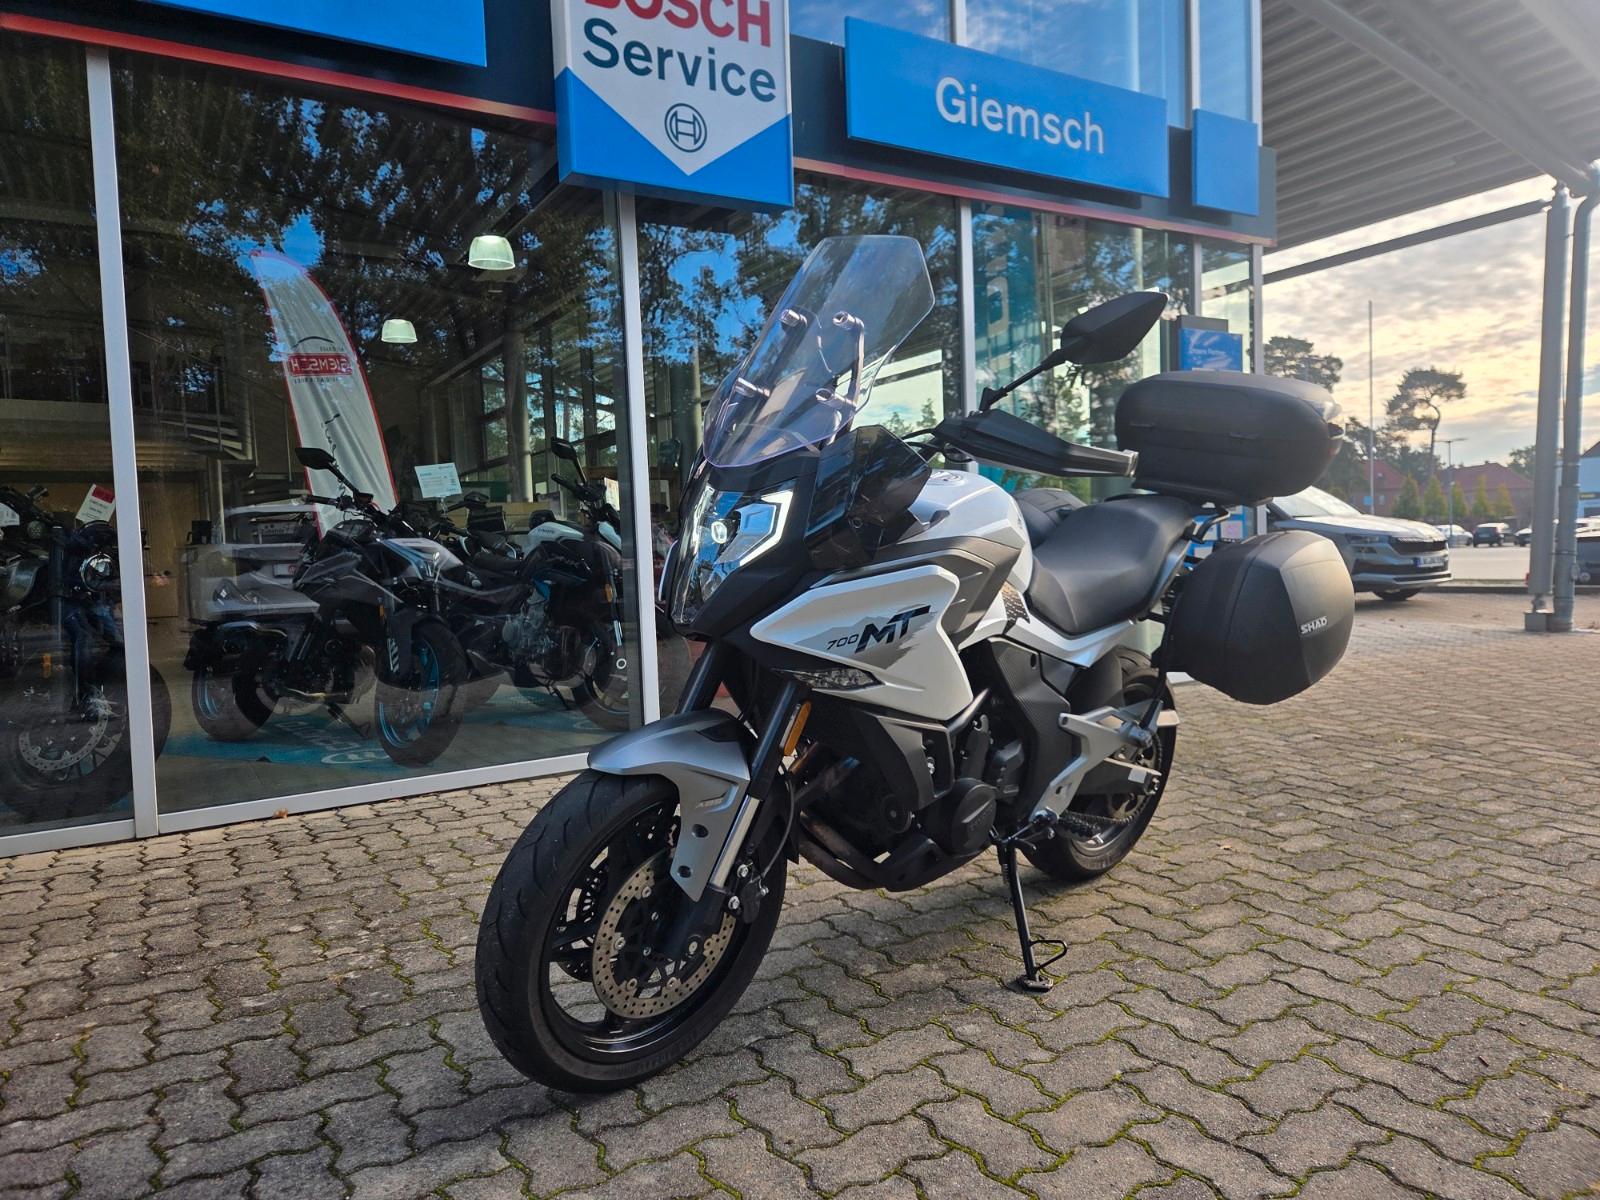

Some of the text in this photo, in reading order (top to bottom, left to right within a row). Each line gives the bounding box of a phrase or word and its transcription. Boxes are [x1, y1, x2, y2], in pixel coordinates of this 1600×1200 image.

[585, 0, 771, 47] SCH
[583, 18, 776, 102] Service
[935, 76, 1104, 154] Giemsch
[826, 605, 931, 654] 700 MT
[1300, 616, 1328, 634] SHAD
